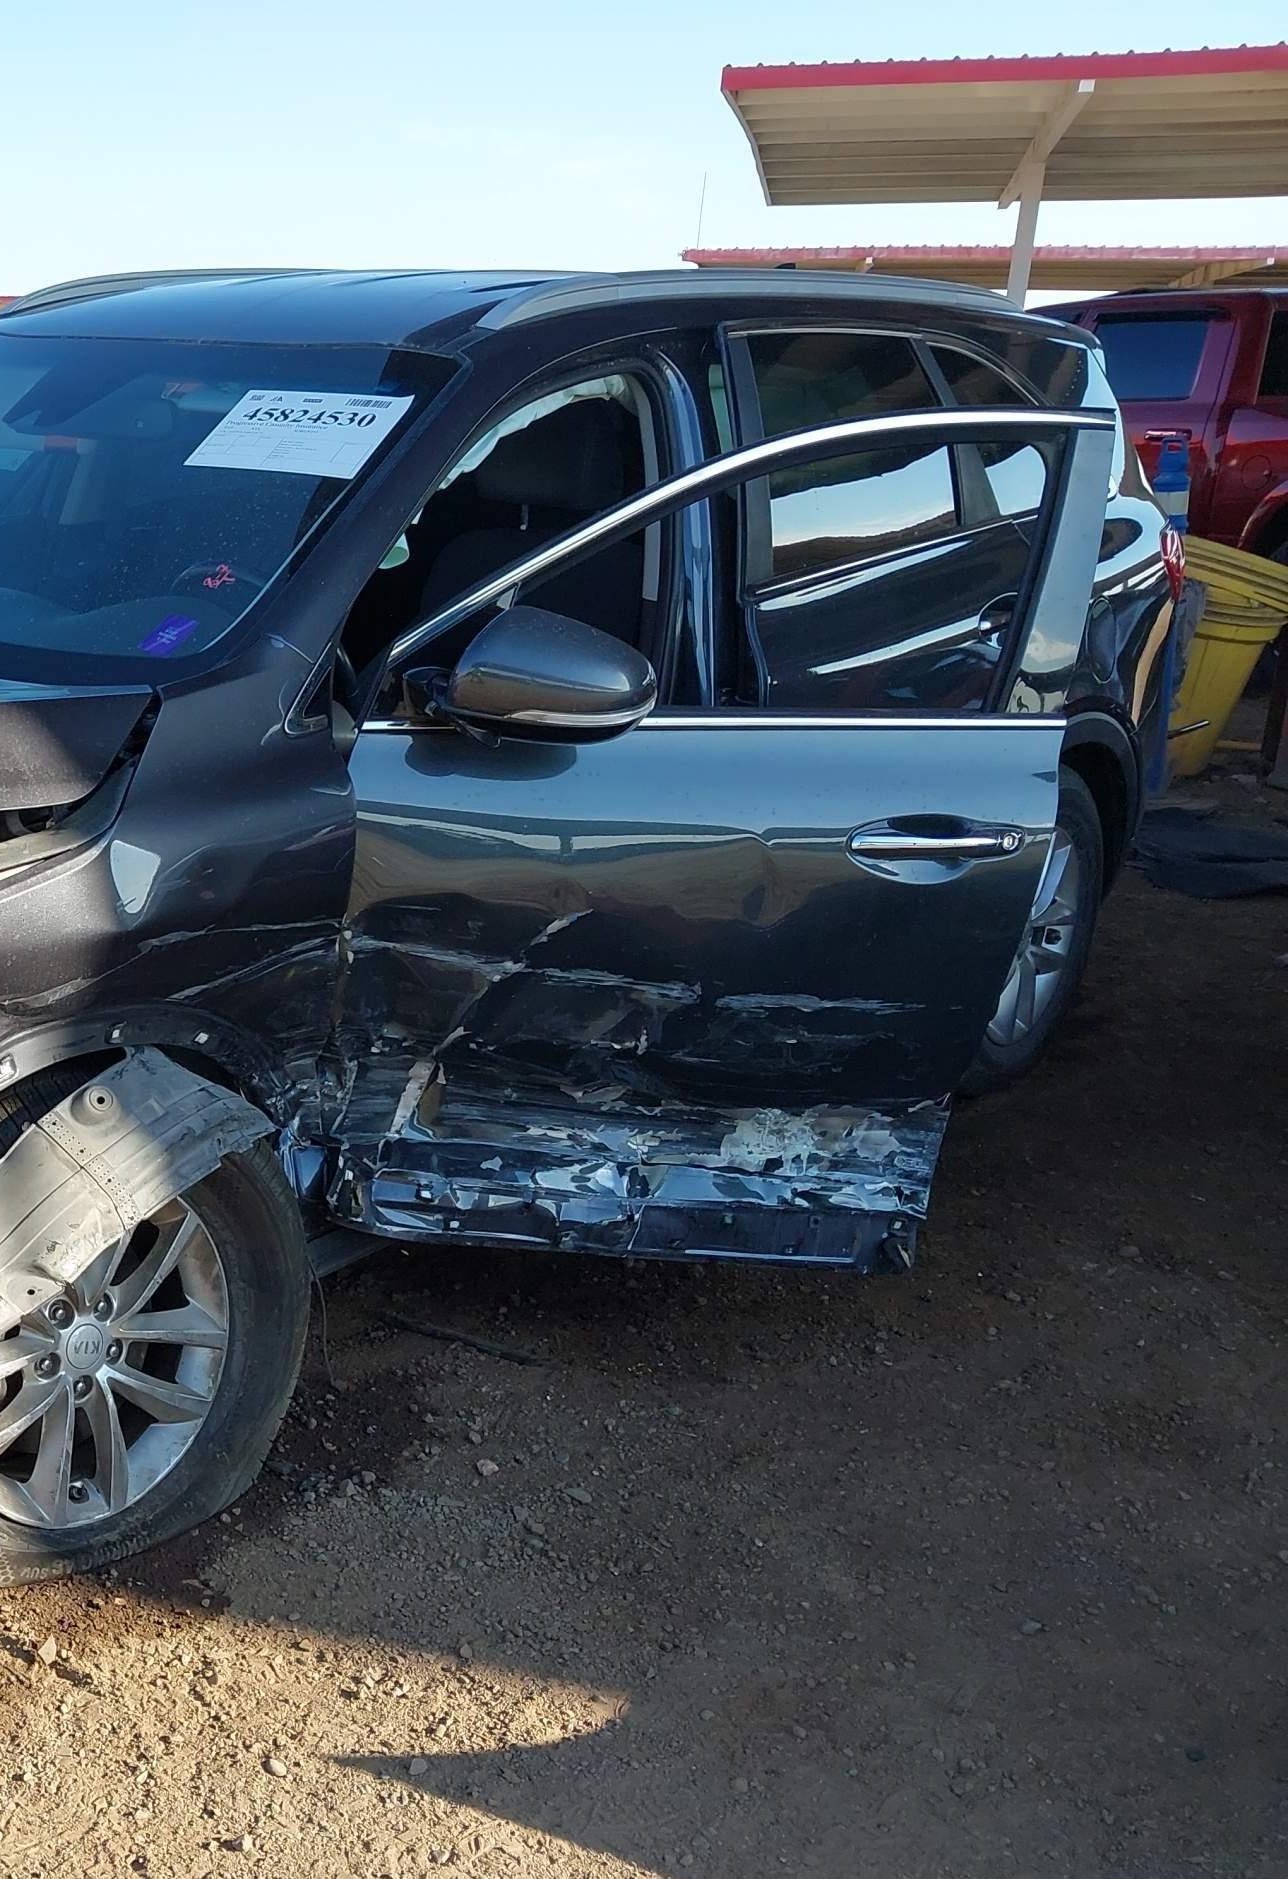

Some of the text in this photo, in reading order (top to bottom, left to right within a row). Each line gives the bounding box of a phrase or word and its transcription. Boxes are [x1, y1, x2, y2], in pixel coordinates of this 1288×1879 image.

[242, 407, 377, 428] 45824530
[73, 1339, 101, 1355] KIA
[20, 1566, 49, 1580] SUV
